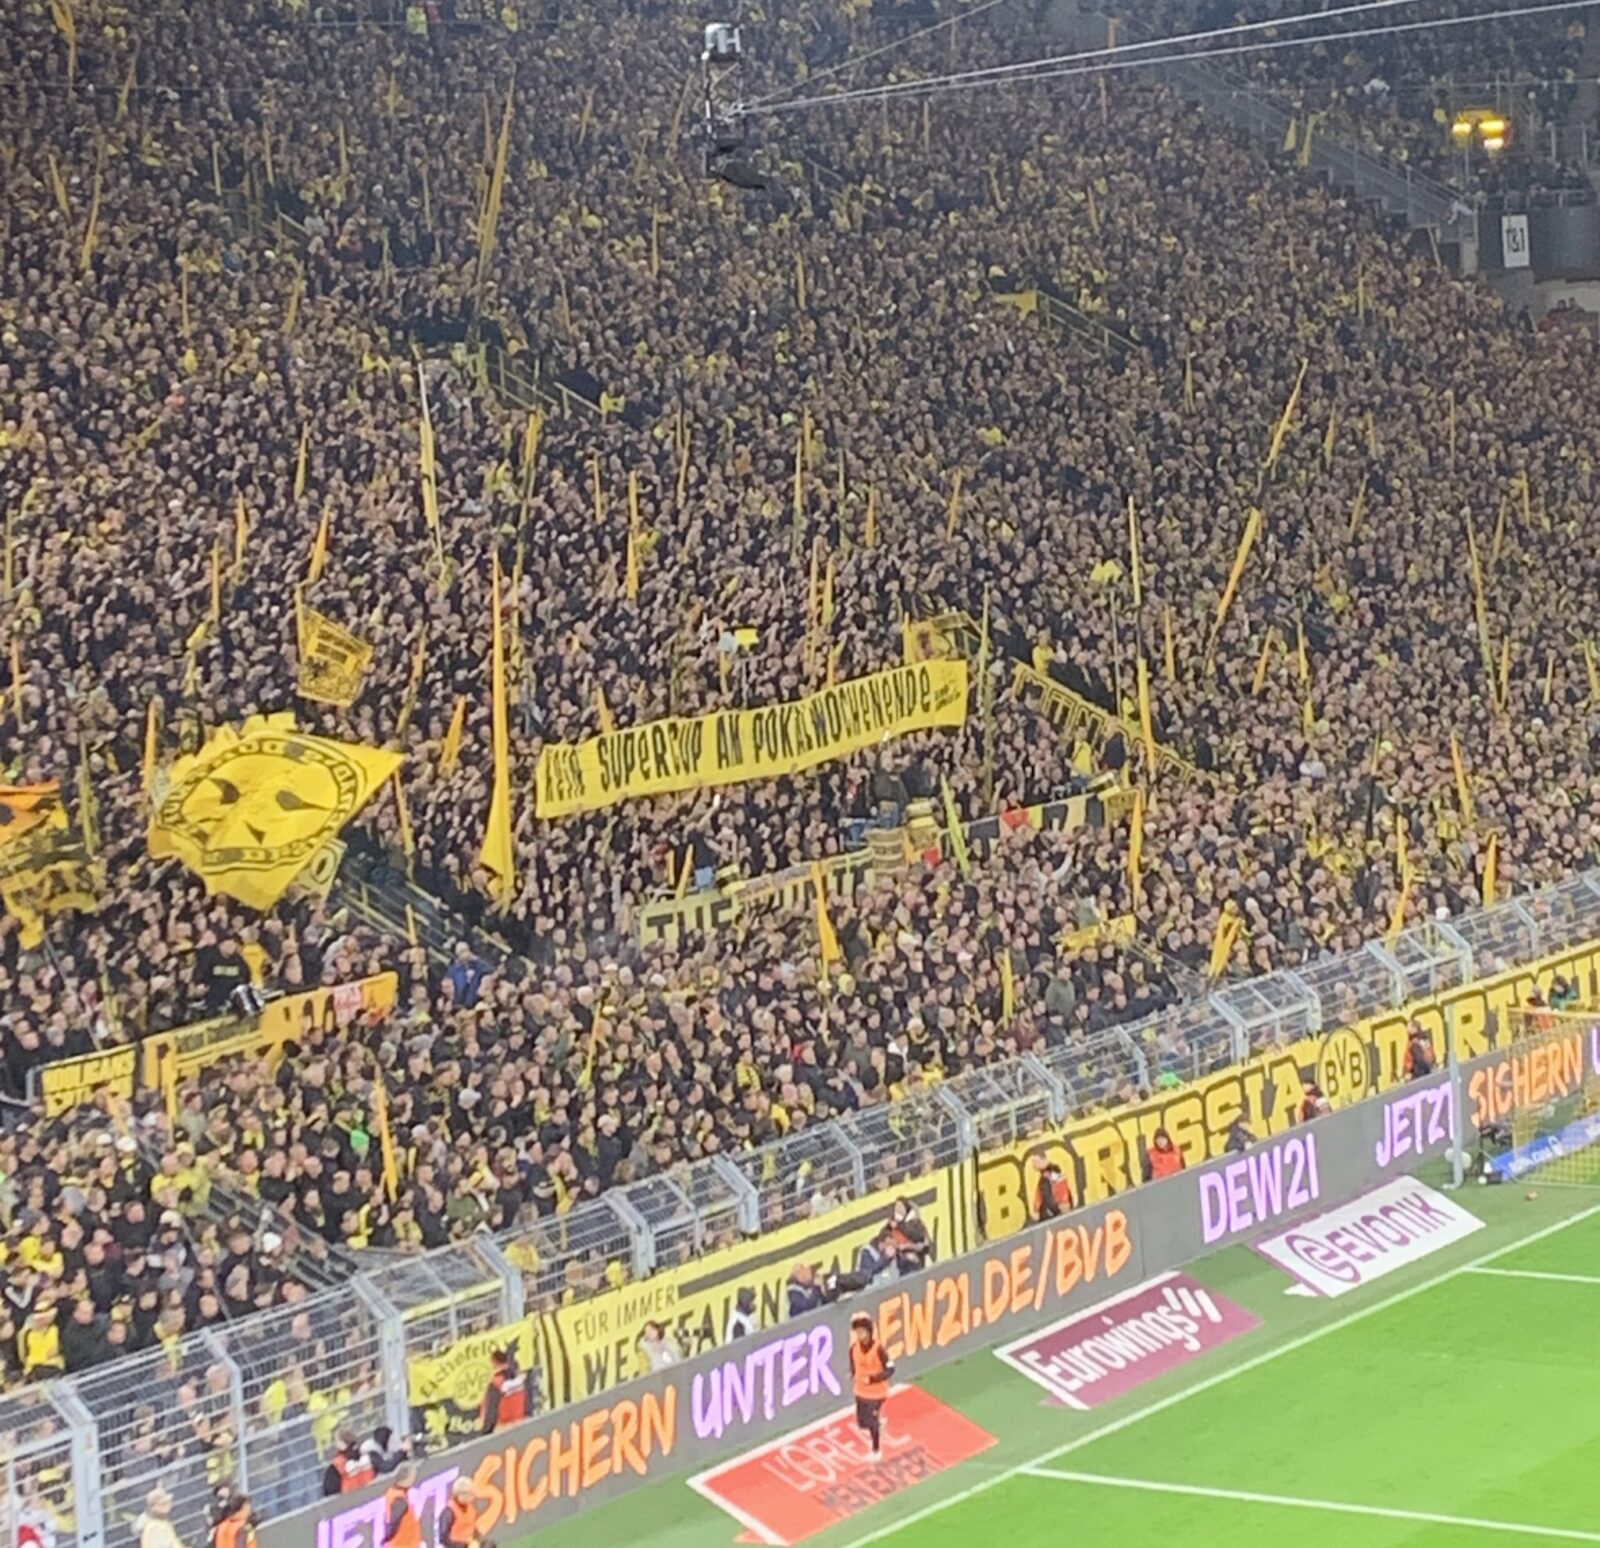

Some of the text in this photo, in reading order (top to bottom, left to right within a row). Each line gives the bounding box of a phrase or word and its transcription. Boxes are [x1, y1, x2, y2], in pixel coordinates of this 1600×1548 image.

[1325, 1036, 1363, 1098] BVB
[1468, 1033, 1583, 1128] SICHERN
[1199, 1132, 1320, 1243] DEW21
[616, 1284, 676, 1329] IMMER
[691, 1208, 1132, 1439] UNTER EW21.DE/BVB
[1020, 1304, 1202, 1392] Eurowings
[472, 1384, 677, 1537] SICHERN
